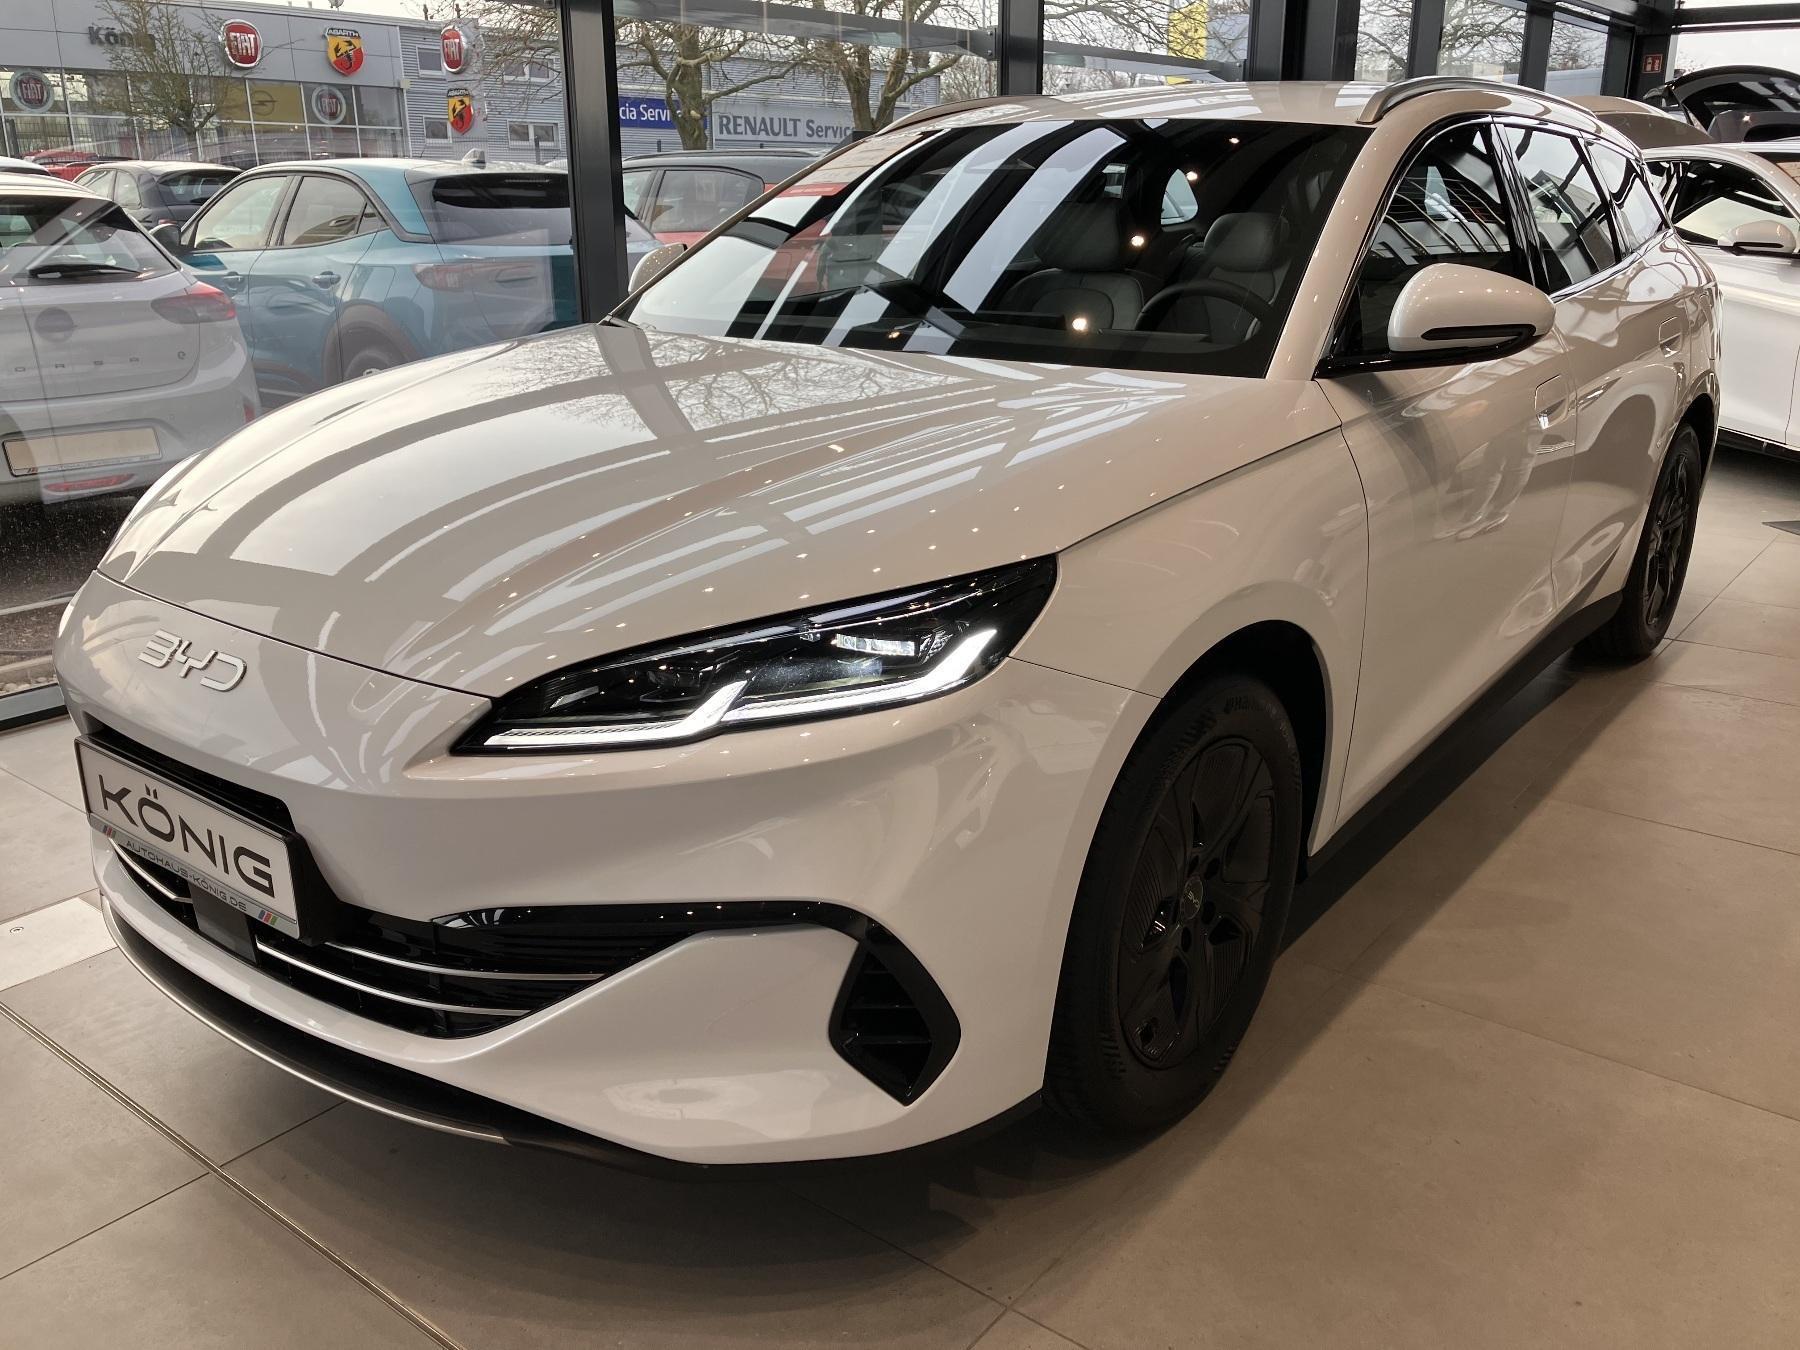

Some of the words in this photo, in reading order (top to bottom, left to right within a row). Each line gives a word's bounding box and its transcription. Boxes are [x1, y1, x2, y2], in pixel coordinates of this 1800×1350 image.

[229, 32, 255, 56] FIAT
[328, 28, 359, 37] ABARTH
[21, 83, 42, 99] FIAT
[719, 115, 801, 137] RENAULT
[806, 119, 854, 138] Servic
[137, 628, 247, 692] BYD
[98, 774, 275, 898] KÖNIG
